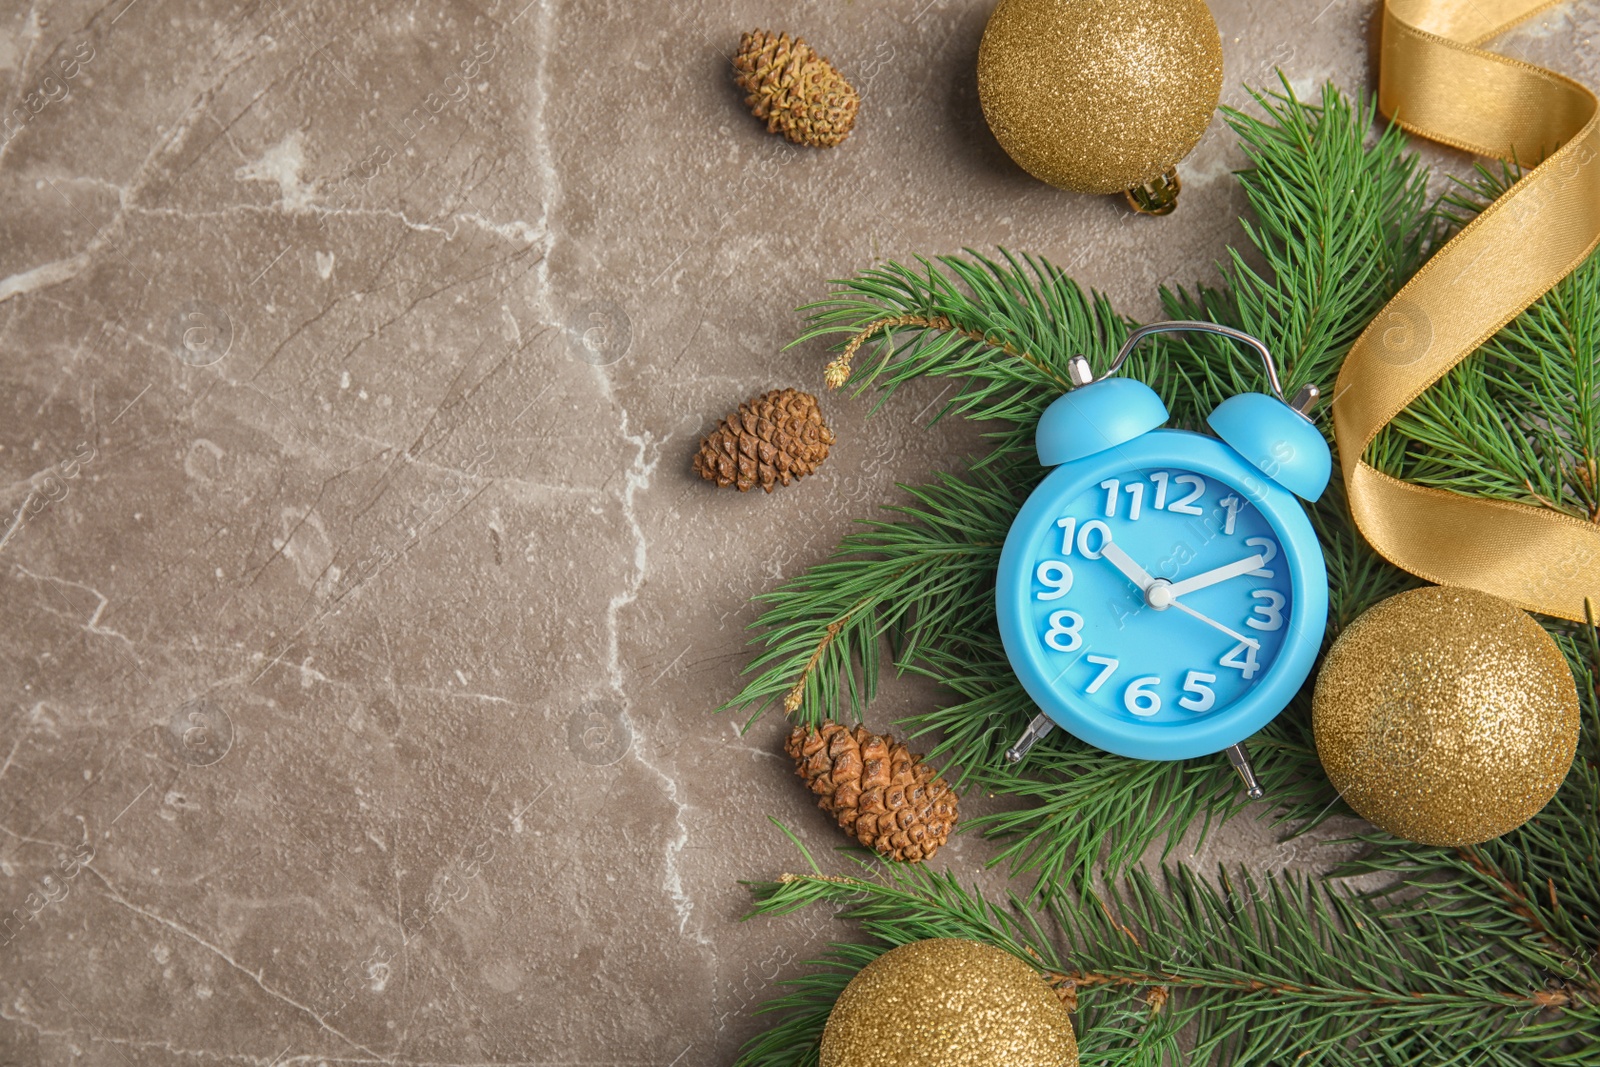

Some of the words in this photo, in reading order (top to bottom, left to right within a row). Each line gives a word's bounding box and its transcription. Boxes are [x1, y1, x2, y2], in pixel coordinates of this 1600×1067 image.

[1100, 478, 1144, 520] 11
[1150, 471, 1207, 516] 12
[1220, 497, 1239, 535] 1
[1057, 517, 1112, 560] 10
[1245, 537, 1277, 578] 2
[1036, 560, 1074, 601] 9
[1044, 610, 1085, 653] 8
[1245, 590, 1286, 632] 3
[1086, 655, 1119, 694] 7
[1219, 638, 1260, 680] 4
[1124, 677, 1161, 717] 6
[1178, 670, 1217, 713] 5
